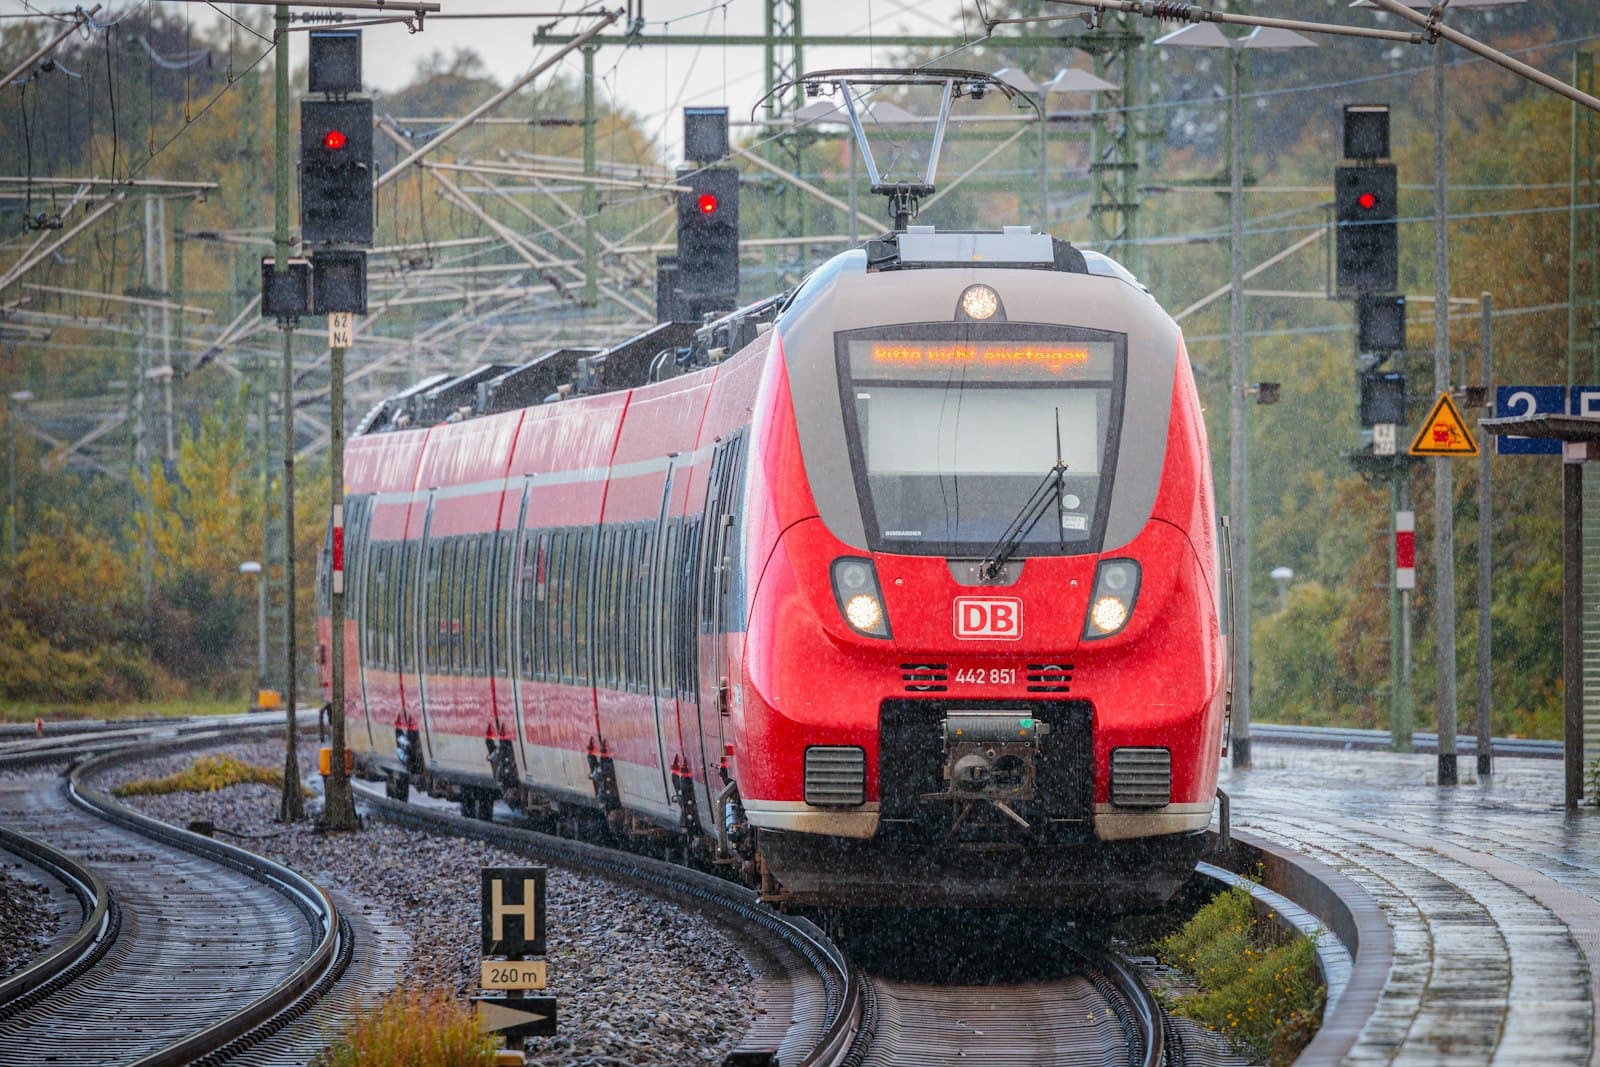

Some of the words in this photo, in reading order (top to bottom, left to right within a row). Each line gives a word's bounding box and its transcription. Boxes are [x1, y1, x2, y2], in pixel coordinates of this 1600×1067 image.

[334, 314, 348, 328] 62
[334, 331, 348, 345] N4
[1507, 391, 1537, 439] 2
[963, 604, 1014, 632] DB
[955, 668, 985, 684] 442
[990, 668, 1016, 684] 851
[491, 879, 535, 941] H
[491, 968, 518, 983] 260
[522, 971, 537, 983] m
